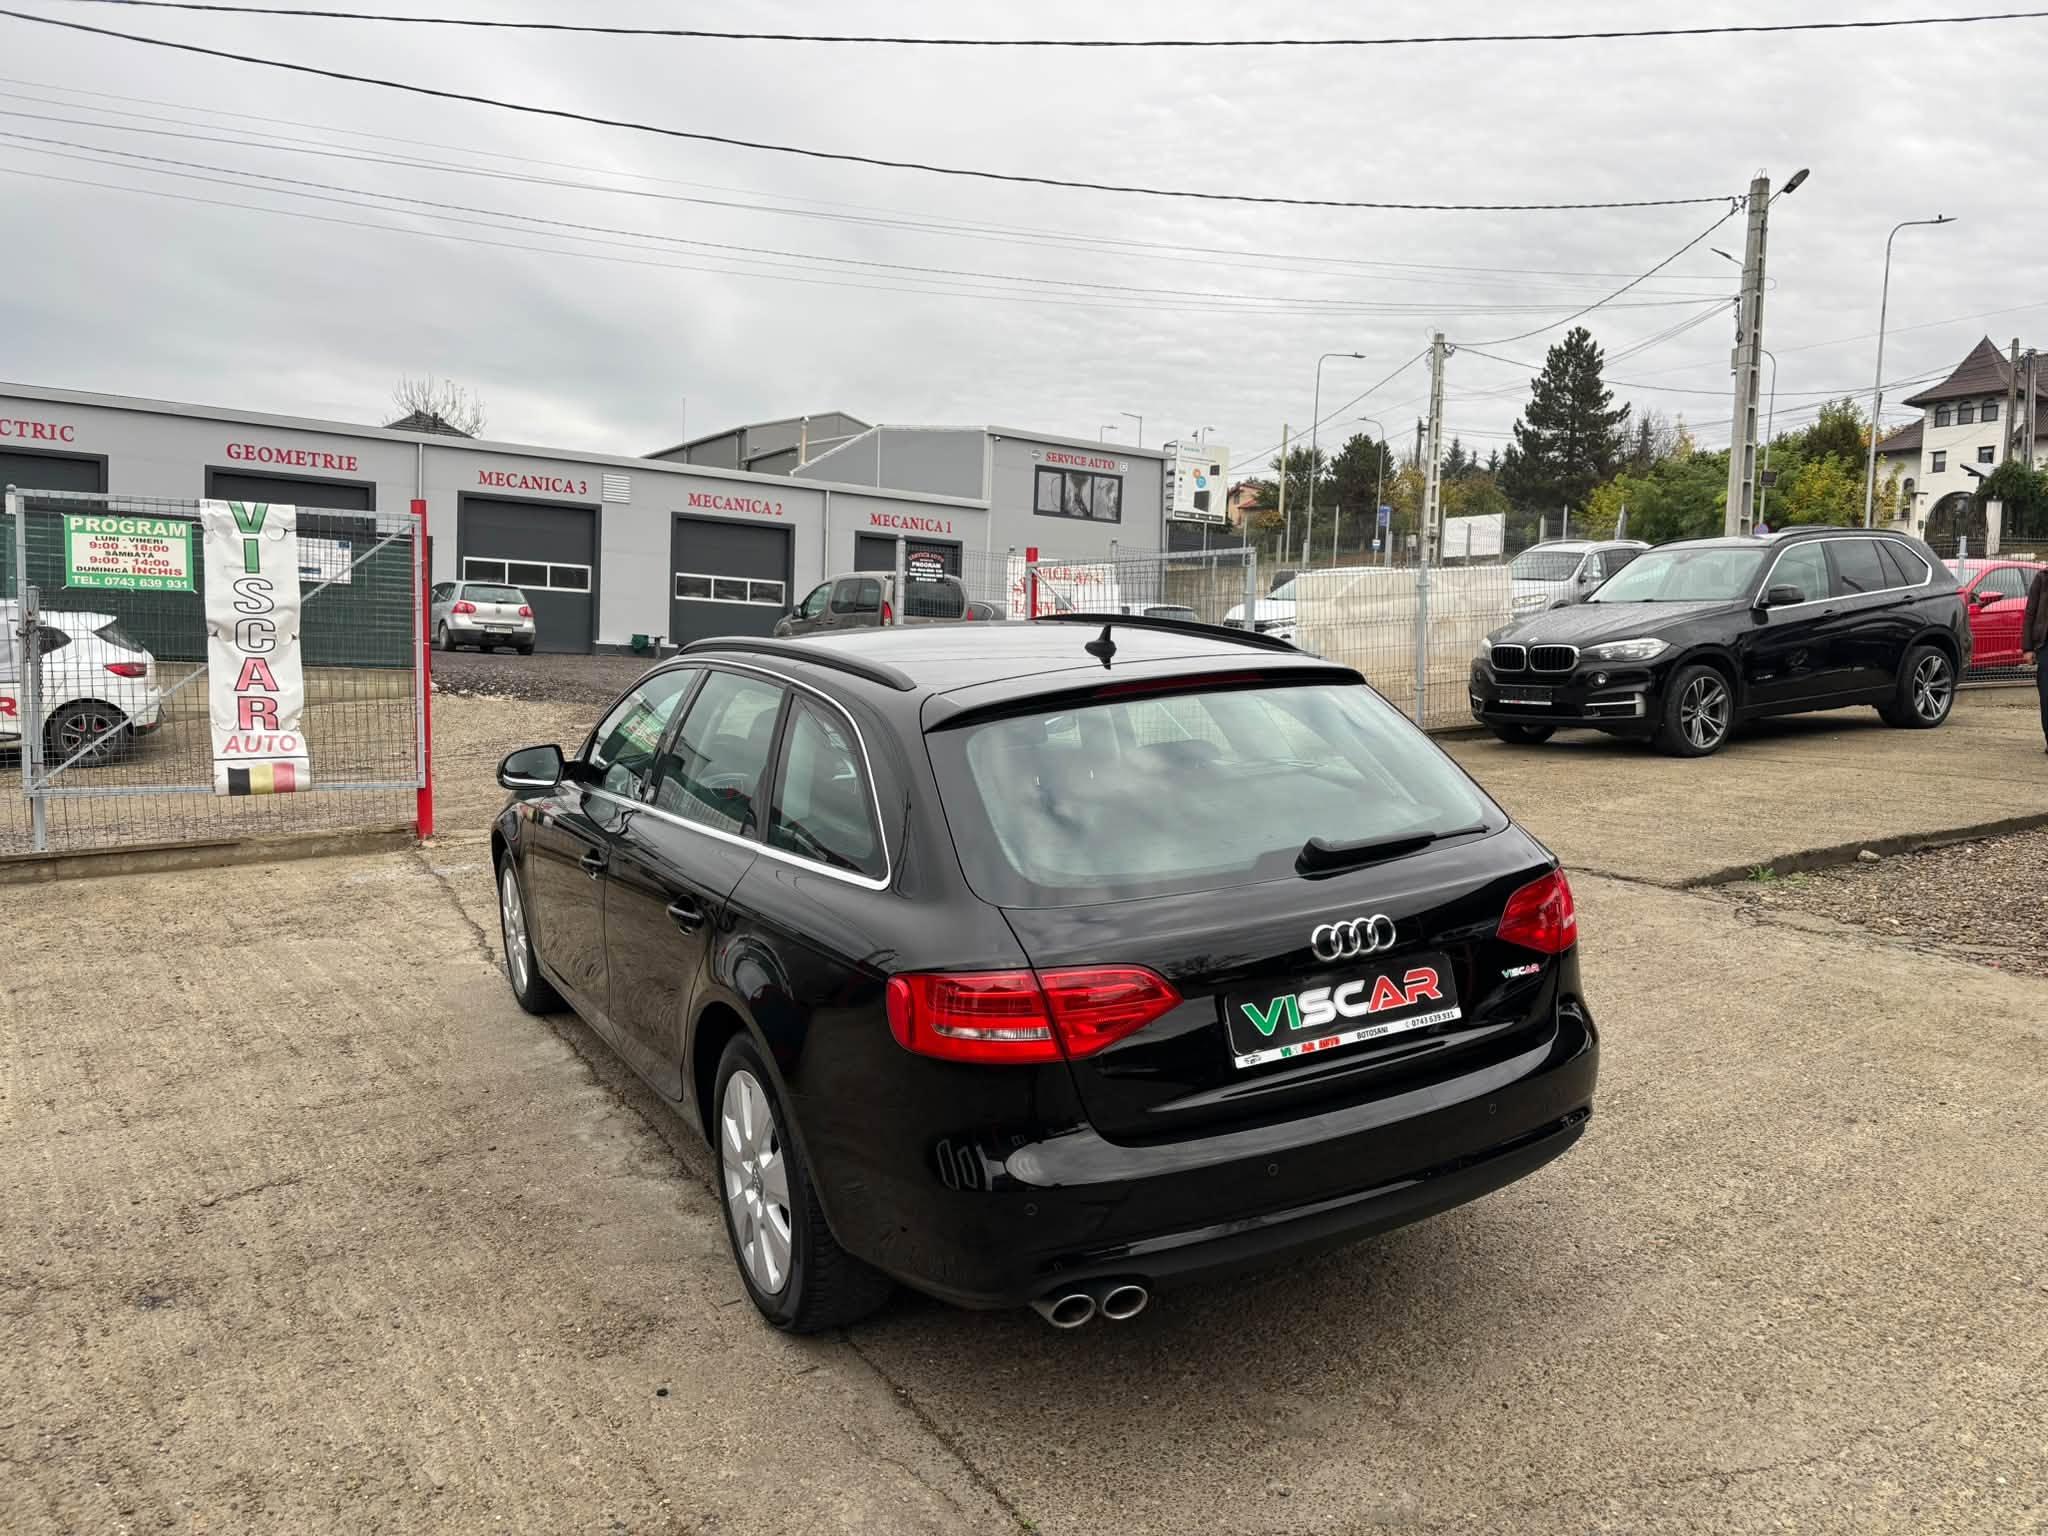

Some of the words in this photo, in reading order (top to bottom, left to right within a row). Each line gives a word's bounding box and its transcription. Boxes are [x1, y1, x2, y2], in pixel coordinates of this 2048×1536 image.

[0, 418, 75, 442] CTRIC
[226, 443, 358, 472] GEOMETRIE
[1046, 452, 1086, 466] SERVICE
[1088, 458, 1115, 470] AUTO
[478, 470, 575, 494] MECANICA
[578, 481, 587, 495] 3
[688, 493, 772, 515] MECANICA
[775, 503, 783, 516] 2
[70, 517, 187, 537] PROGRAM
[870, 512, 943, 533] MECANICA
[946, 520, 952, 534] 1
[89, 541, 119, 550] 9:00
[133, 544, 169, 553] 18:00
[95, 535, 119, 543] LUNI
[129, 537, 163, 545] VINERI
[89, 556, 119, 565] 9:00
[133, 558, 169, 567] 14:00
[72, 575, 101, 585] TEL:
[104, 577, 135, 587] 0743
[228, 501, 280, 731] VISCAR
[222, 735, 297, 754] AUTO
[1501, 963, 1540, 979] VISCAR
[1240, 967, 1443, 1037] VISCAR
[1357, 1026, 1389, 1040] BOTOSANI
